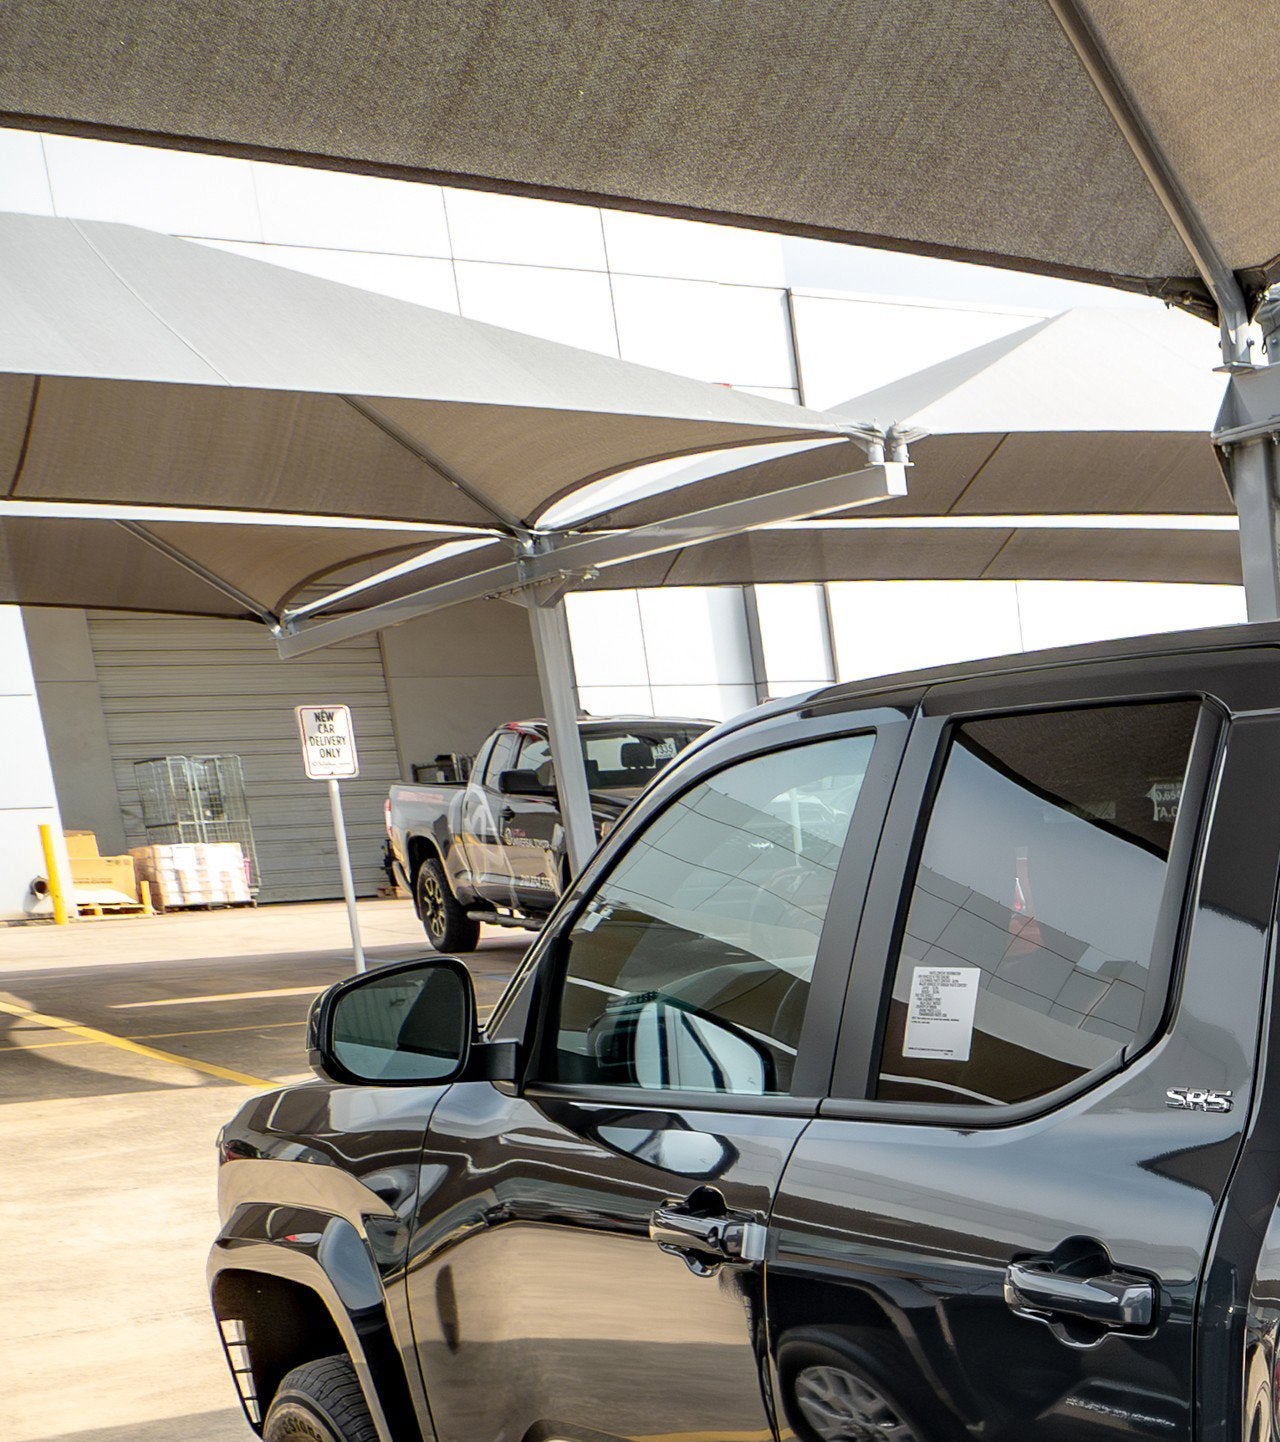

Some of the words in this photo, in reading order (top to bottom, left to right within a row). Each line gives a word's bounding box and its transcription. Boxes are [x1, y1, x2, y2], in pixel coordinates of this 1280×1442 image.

[314, 711, 334, 722] NEW
[318, 724, 335, 734] CAR
[309, 736, 346, 746] DELIVERY
[319, 748, 341, 758] ONLY
[1165, 1087, 1234, 1113] SR5
